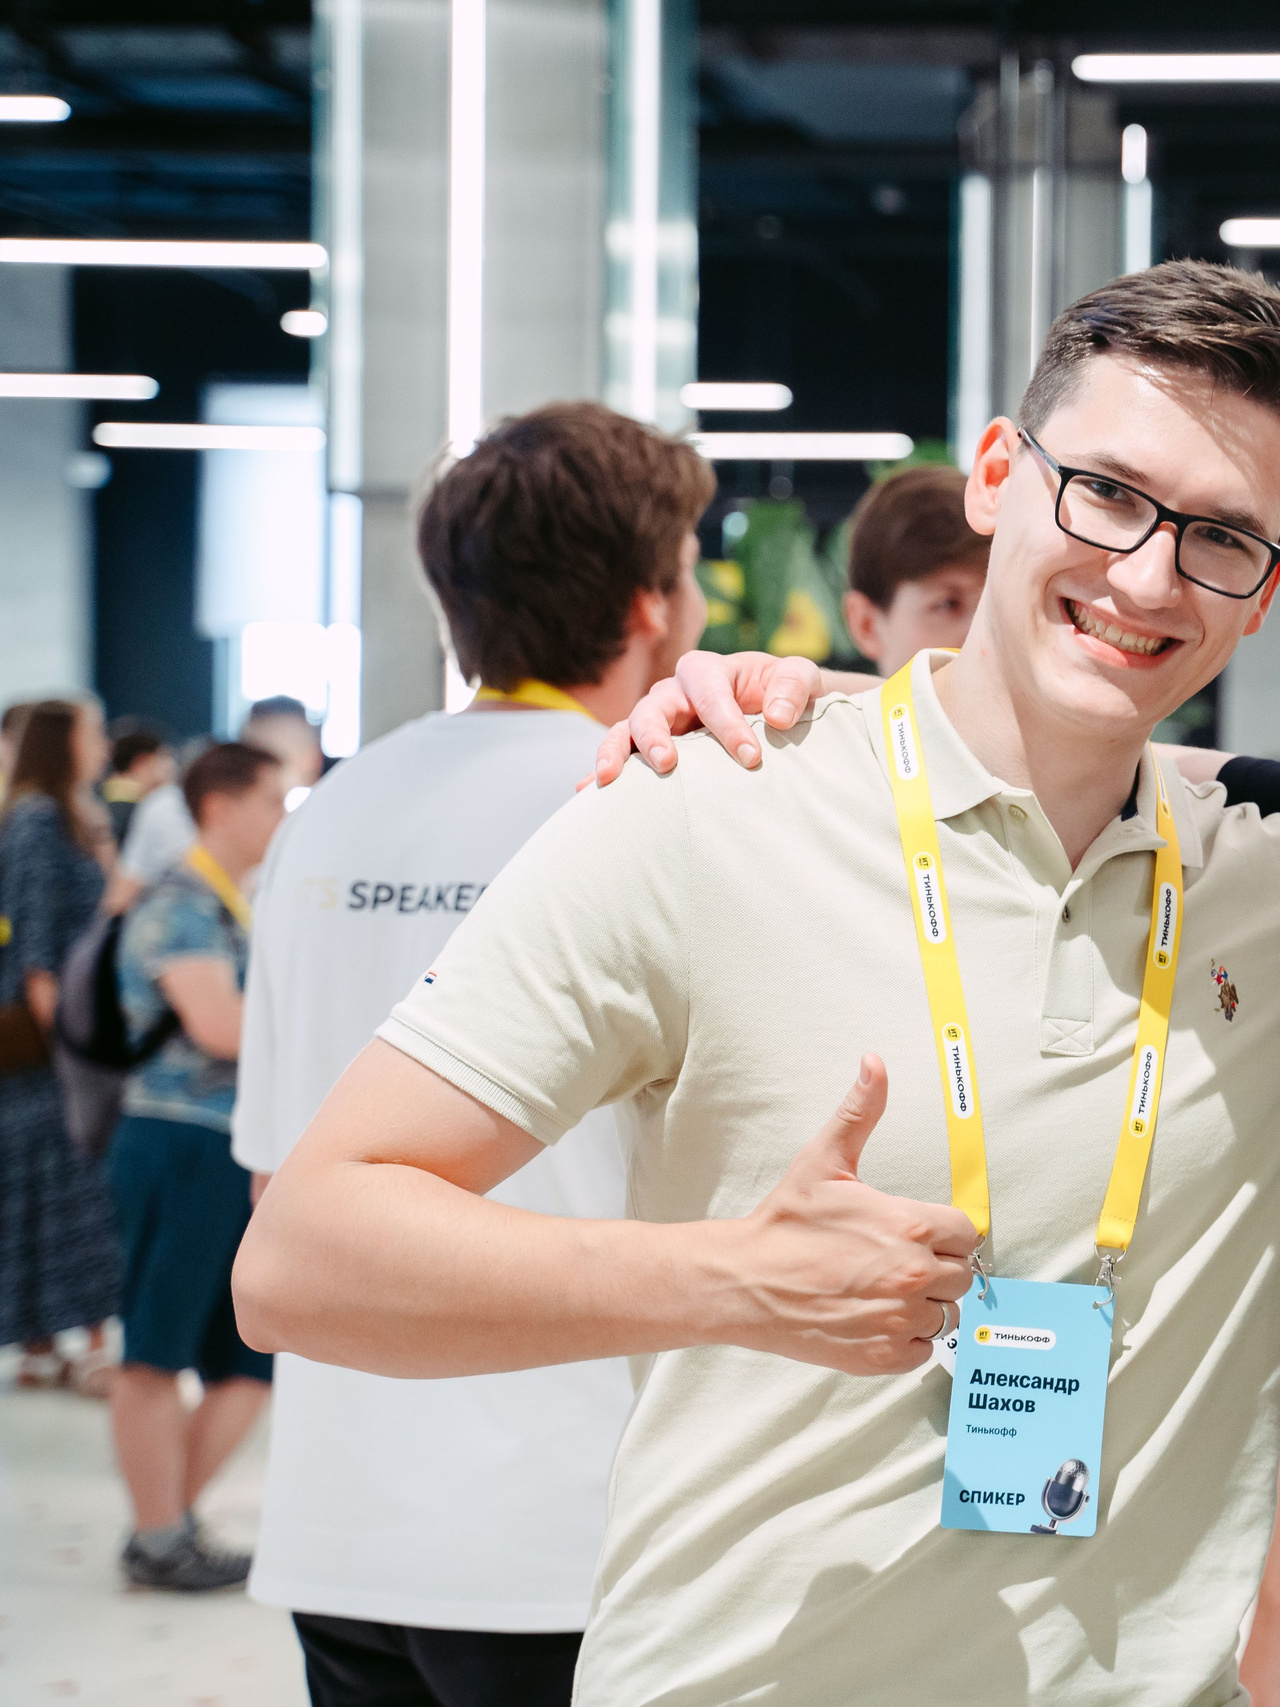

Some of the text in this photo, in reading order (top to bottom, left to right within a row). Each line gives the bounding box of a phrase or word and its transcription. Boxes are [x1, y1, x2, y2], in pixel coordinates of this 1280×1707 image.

[897, 721, 912, 774] ТИНЬКОФФ
[348, 880, 488, 912] SPEAKE
[922, 873, 939, 938] ТИНЬКОФФ
[1160, 888, 1173, 947] ТИНЬКОФФ
[952, 1045, 967, 1112] ТИНЬКОФФ
[1138, 1051, 1153, 1114] ТИНЬКОФФ
[994, 1332, 1051, 1344] ТИНЬКОФФ
[969, 1368, 1081, 1396] Александр
[968, 1392, 1036, 1413] Шахов
[965, 1424, 1018, 1438] Тинькофф
[958, 1489, 1026, 1506] СПИКЕР
